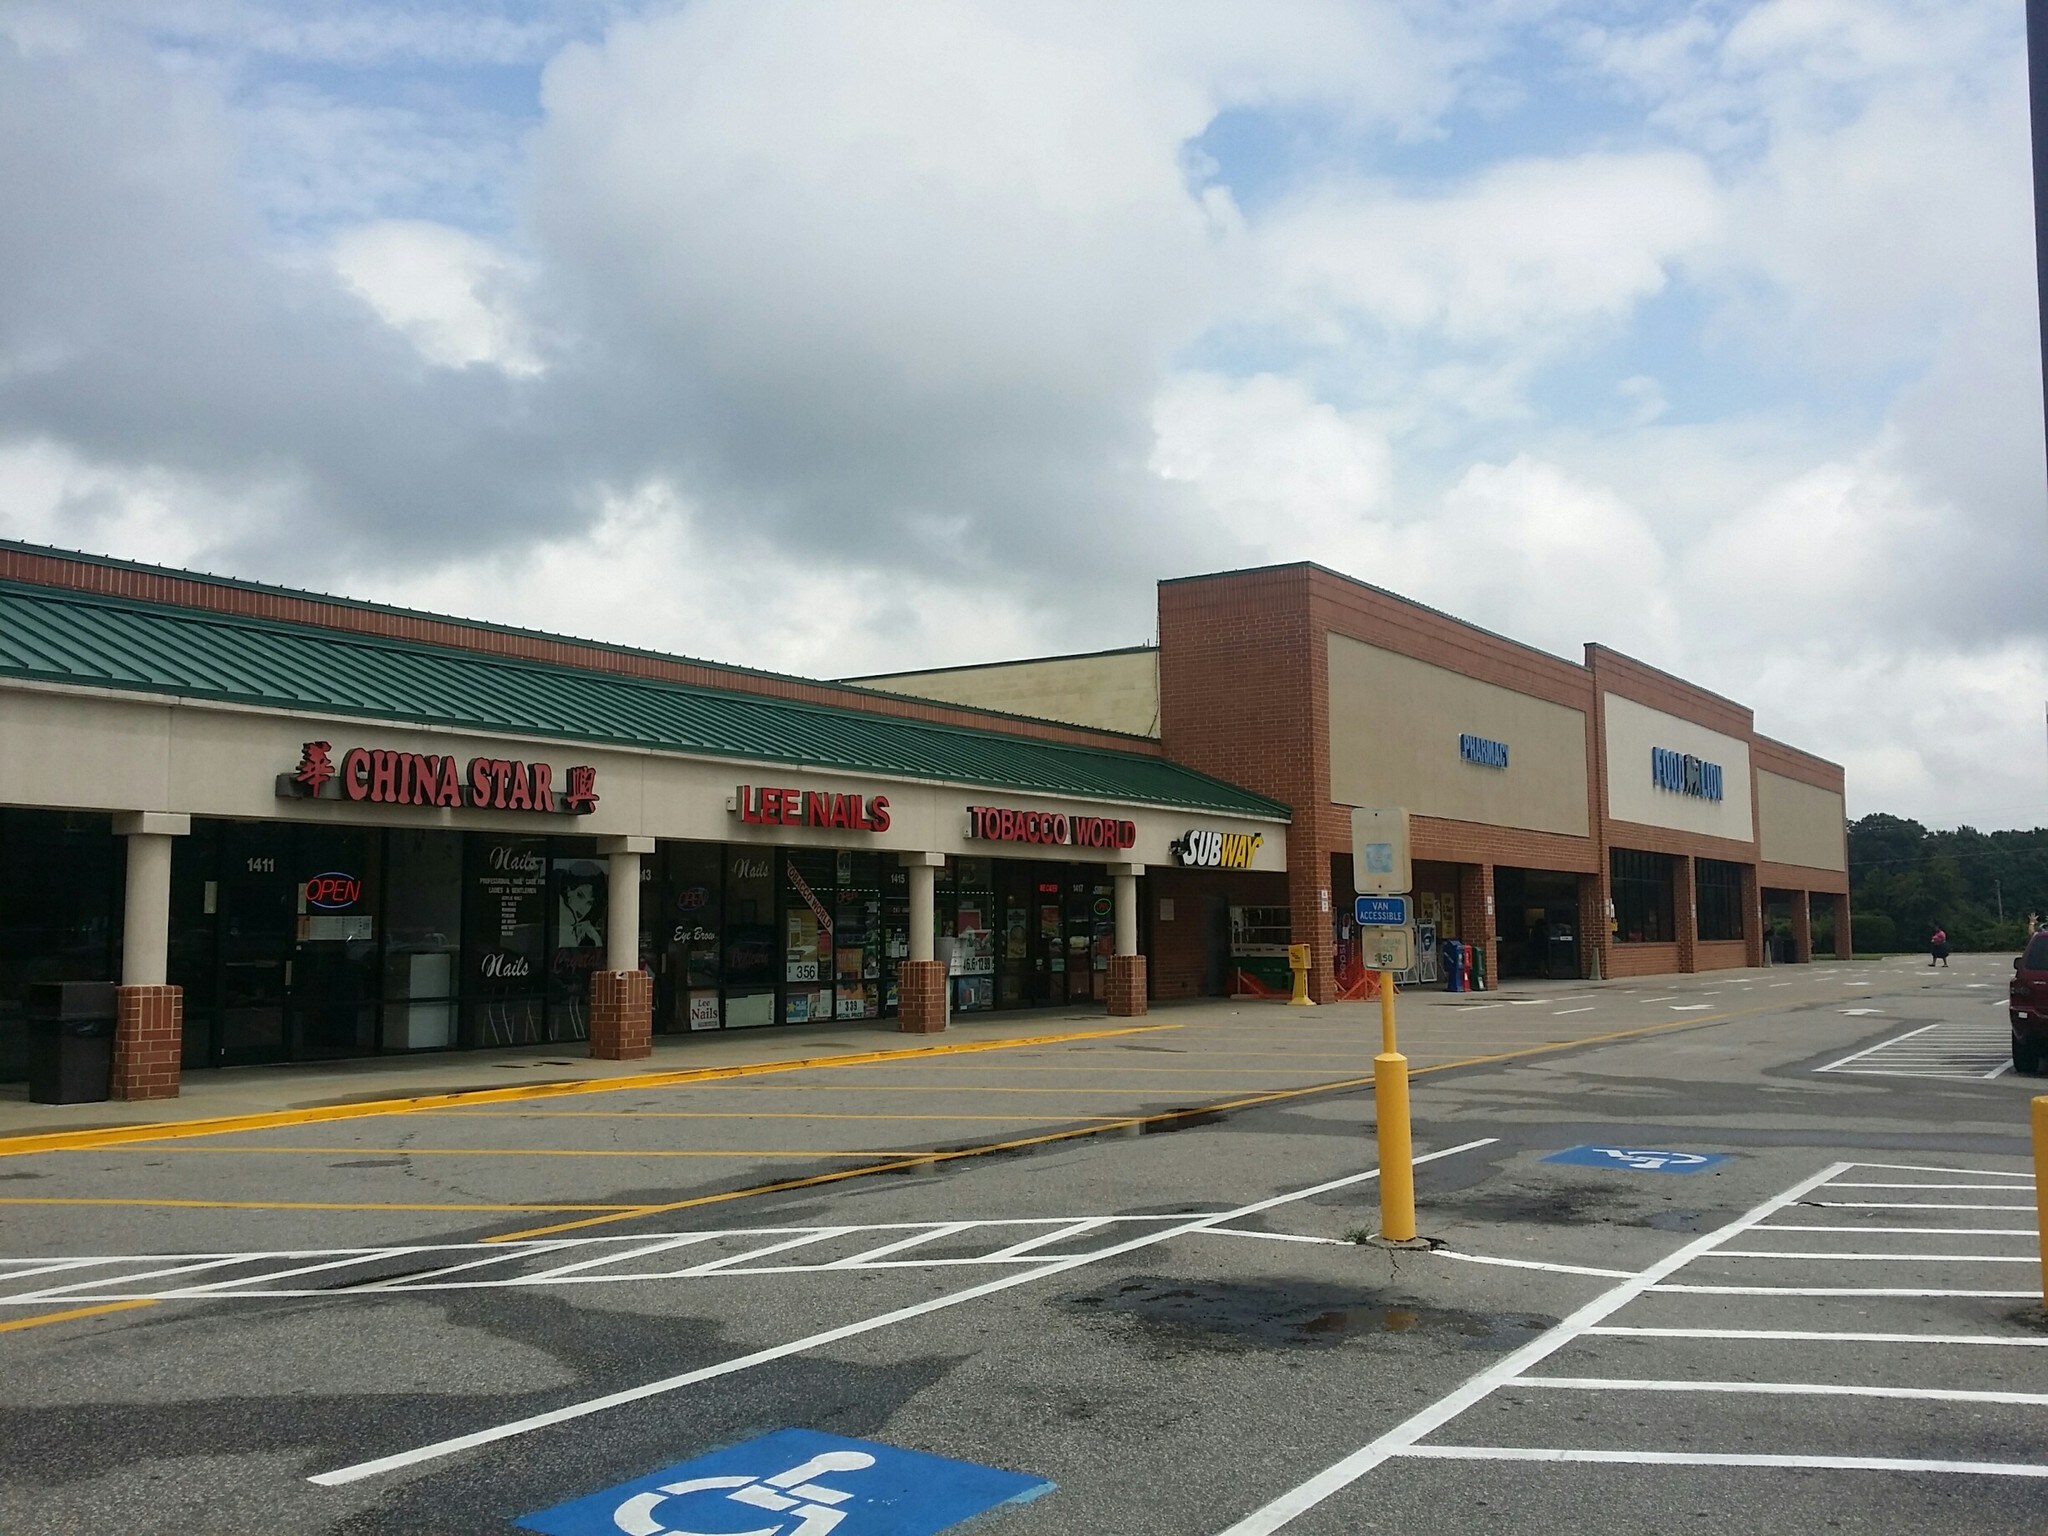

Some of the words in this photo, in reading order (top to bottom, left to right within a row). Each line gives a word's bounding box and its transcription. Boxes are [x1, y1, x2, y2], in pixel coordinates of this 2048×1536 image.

[1460, 734, 1509, 768] PHARMACY
[297, 741, 335, 798] 華
[342, 748, 462, 808] CHINA
[467, 757, 554, 812] STAR
[1652, 746, 1685, 792] FOOD
[1699, 760, 1723, 801] LION
[737, 785, 802, 826] LEE
[802, 790, 890, 832] NAILS
[968, 806, 1068, 845] TOBACCO
[1070, 816, 1136, 849] WORLD
[489, 846, 539, 872] Nails
[1183, 828, 1264, 869] SUBWAY
[246, 857, 275, 872] 1411
[733, 858, 769, 879] Nails
[891, 873, 905, 884] 1415
[305, 879, 361, 902] OPEN
[788, 867, 813, 902] OBACCO
[811, 900, 832, 929] WORLD
[1360, 911, 1402, 921] ACCESSIBLE
[1372, 902, 1389, 911] VAN
[674, 926, 691, 943] Eye
[693, 927, 716, 941] Brow
[481, 953, 530, 977] Nails
[796, 965, 816, 979] 356
[1339, 944, 1348, 980] pepsi
[691, 1008, 718, 1020] Nails
[698, 999, 711, 1007] Lee
[844, 1000, 858, 1012] 339
